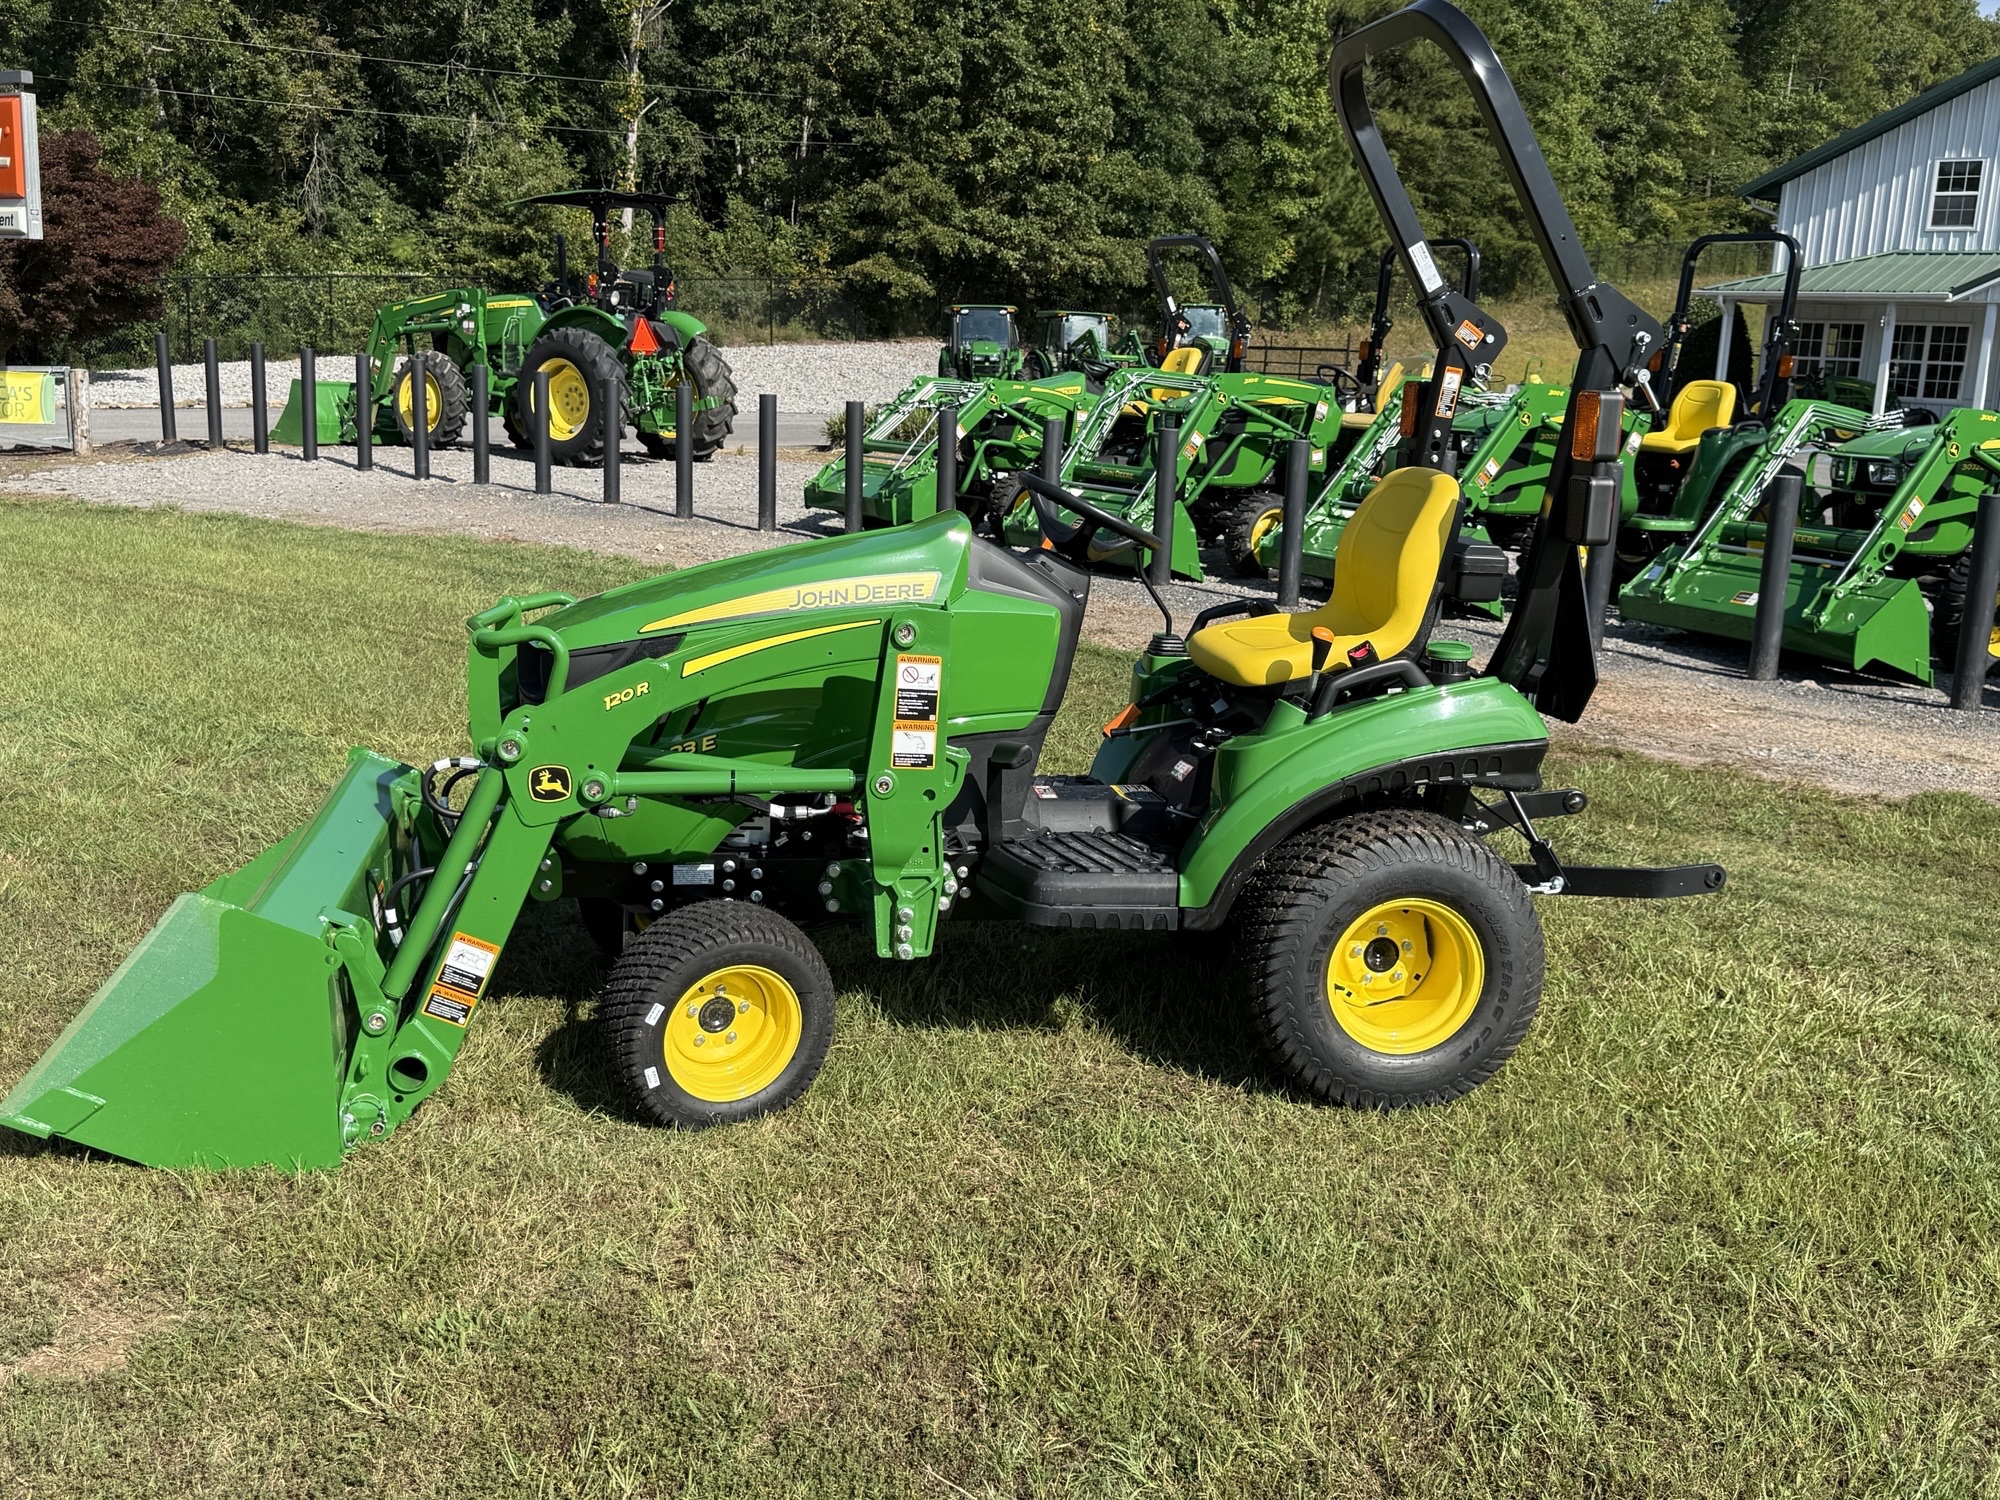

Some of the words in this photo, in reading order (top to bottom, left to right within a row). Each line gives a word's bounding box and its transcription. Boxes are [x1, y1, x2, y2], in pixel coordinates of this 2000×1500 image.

[0, 402, 24, 418] OR
[1100, 468, 1115, 477] JOHN
[1115, 469, 1134, 480] DEERE
[789, 588, 848, 608] JOHN
[855, 583, 925, 601] DEERE
[906, 656, 940, 664] WARNING
[603, 688, 635, 712] 120
[636, 681, 651, 698] R
[702, 734, 718, 752] E
[466, 937, 494, 952] WARNING
[444, 990, 471, 1004] WARNING
